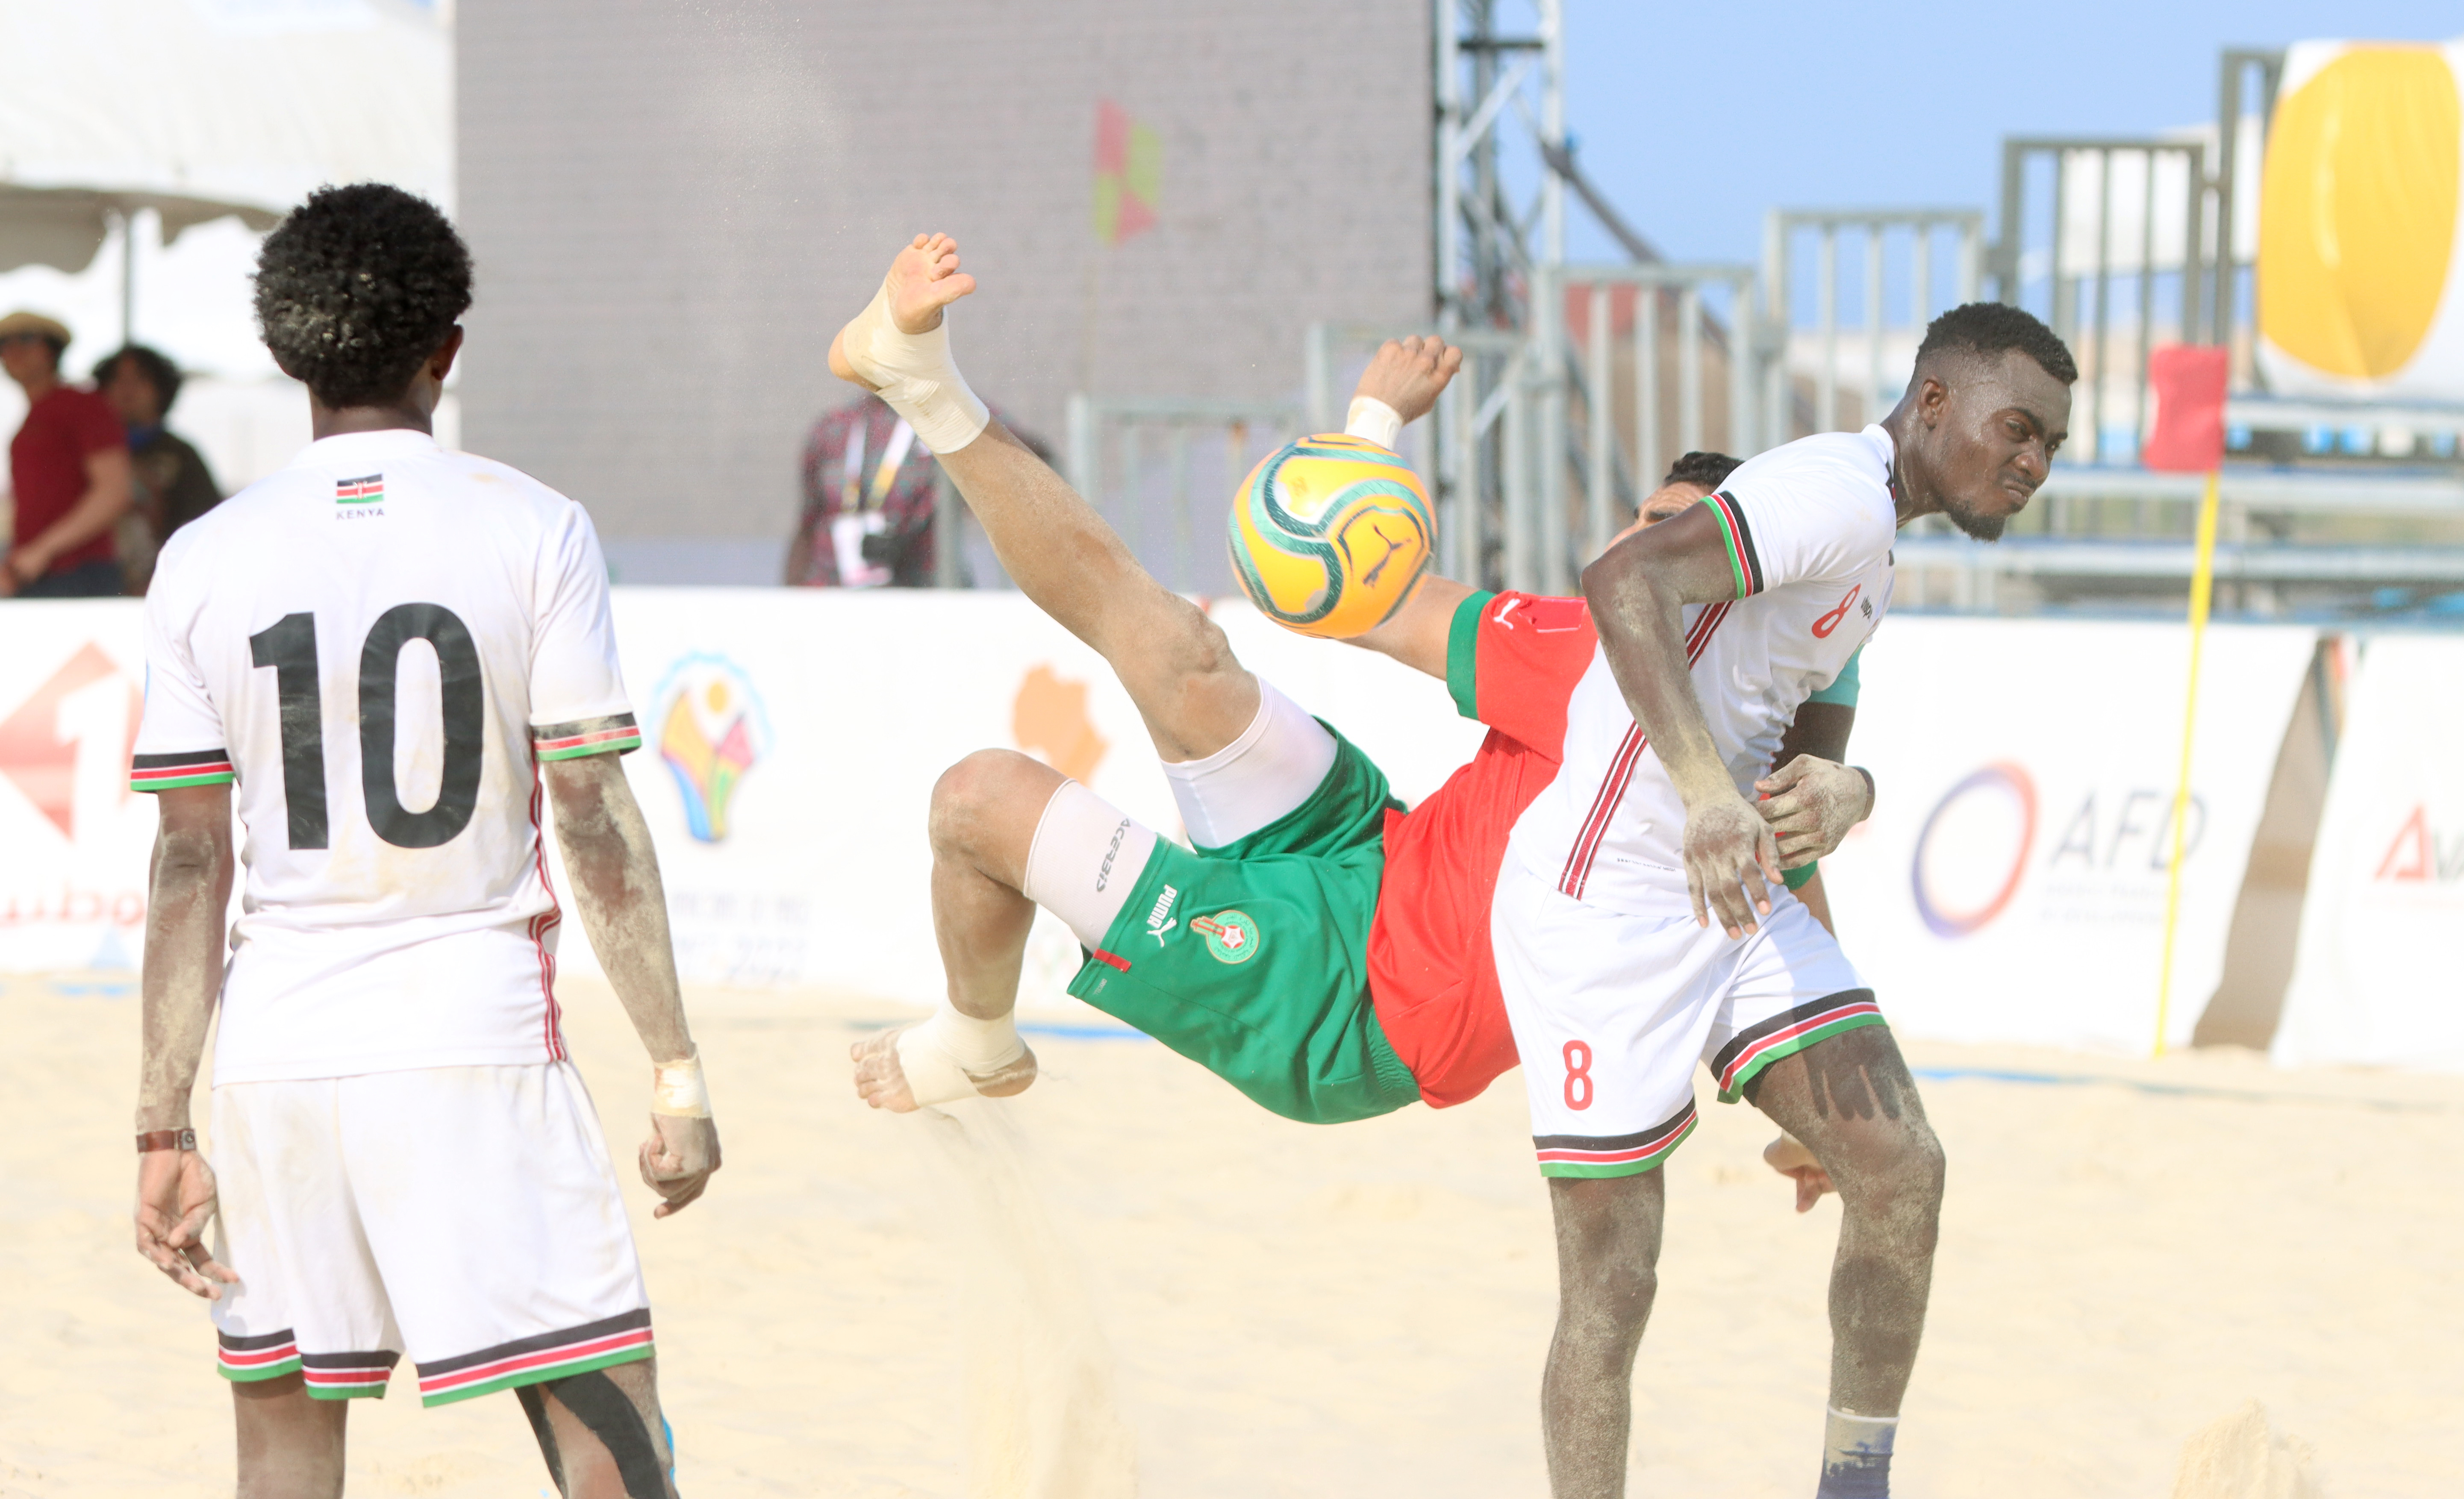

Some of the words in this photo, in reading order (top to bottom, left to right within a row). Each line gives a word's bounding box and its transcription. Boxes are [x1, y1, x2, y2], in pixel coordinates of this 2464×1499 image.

[336, 508, 385, 520] KENYA
[1811, 583, 1861, 638] 8
[249, 602, 483, 850] 10
[2046, 785, 2212, 872] AFD
[1146, 883, 1178, 929] PUMA
[1563, 1039, 1593, 1111] 8
